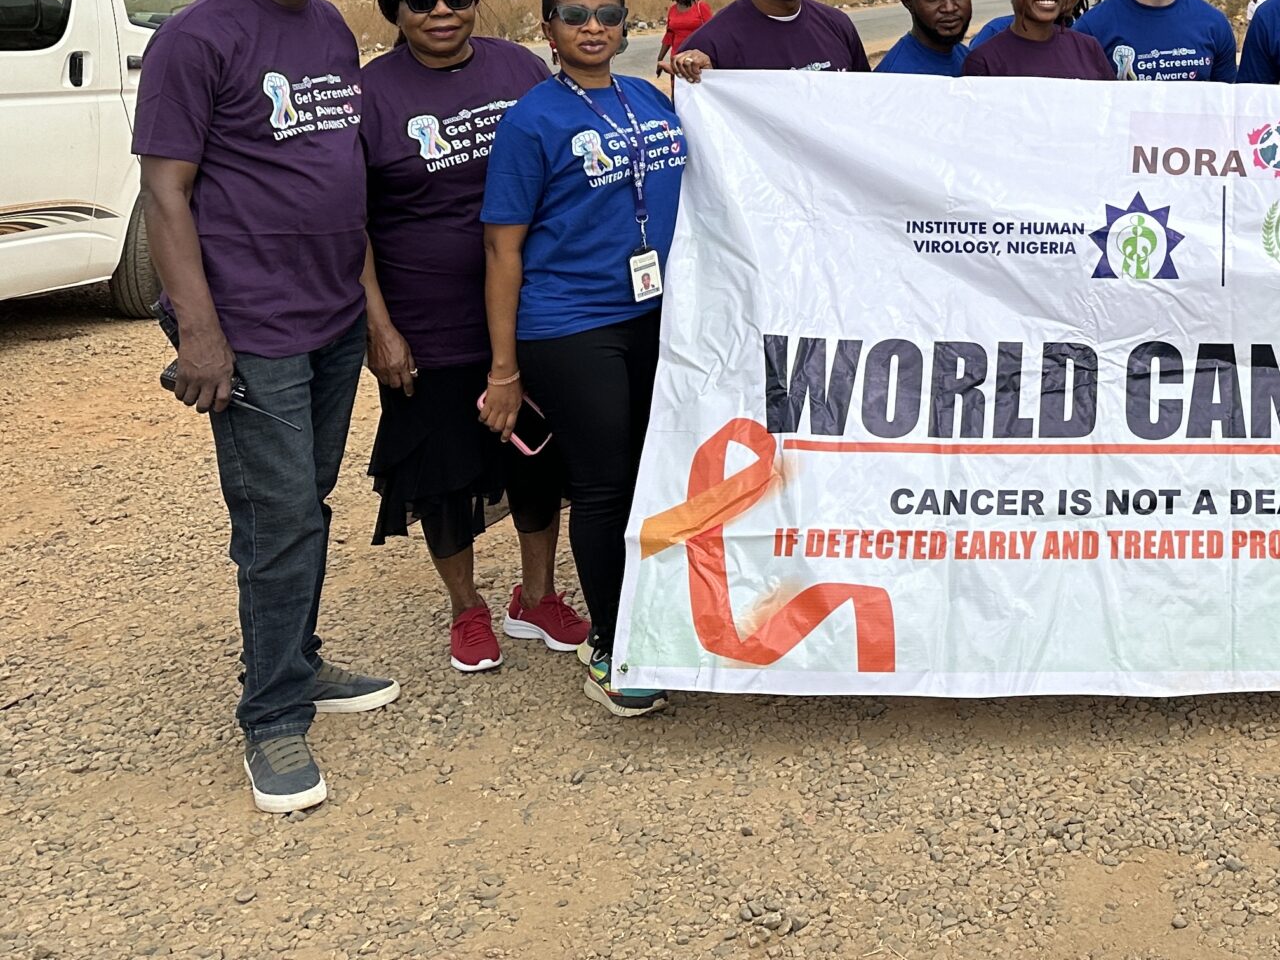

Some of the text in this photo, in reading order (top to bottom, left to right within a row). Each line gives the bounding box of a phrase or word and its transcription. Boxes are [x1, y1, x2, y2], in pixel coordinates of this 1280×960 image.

[1137, 57, 1204, 70] Get Screened
[1138, 71, 1188, 81] Be Aware
[294, 92, 312, 104] Get
[298, 110, 313, 122] Be
[273, 124, 316, 141] UNITED
[445, 122, 472, 136] Get
[451, 138, 471, 150] Be
[608, 140, 627, 150] Ge
[426, 152, 469, 173] UNITED
[613, 154, 629, 167] Be
[1132, 145, 1248, 178] NORA
[589, 171, 623, 188] UNITED
[906, 220, 1085, 235] INSTITUTE OF HUMAN
[913, 240, 1077, 257] VIROLOGY, NIGERIA
[763, 334, 1099, 439] WORLD
[890, 488, 1045, 516] CANCER
[1057, 489, 1092, 516] IS
[1105, 489, 1182, 516] NOT
[1192, 489, 1218, 515] A
[774, 528, 799, 557] IF
[805, 529, 947, 559] DETECTED
[954, 530, 1036, 559] EARLY
[1043, 530, 1099, 559] AND
[1107, 530, 1224, 559] TREATED
